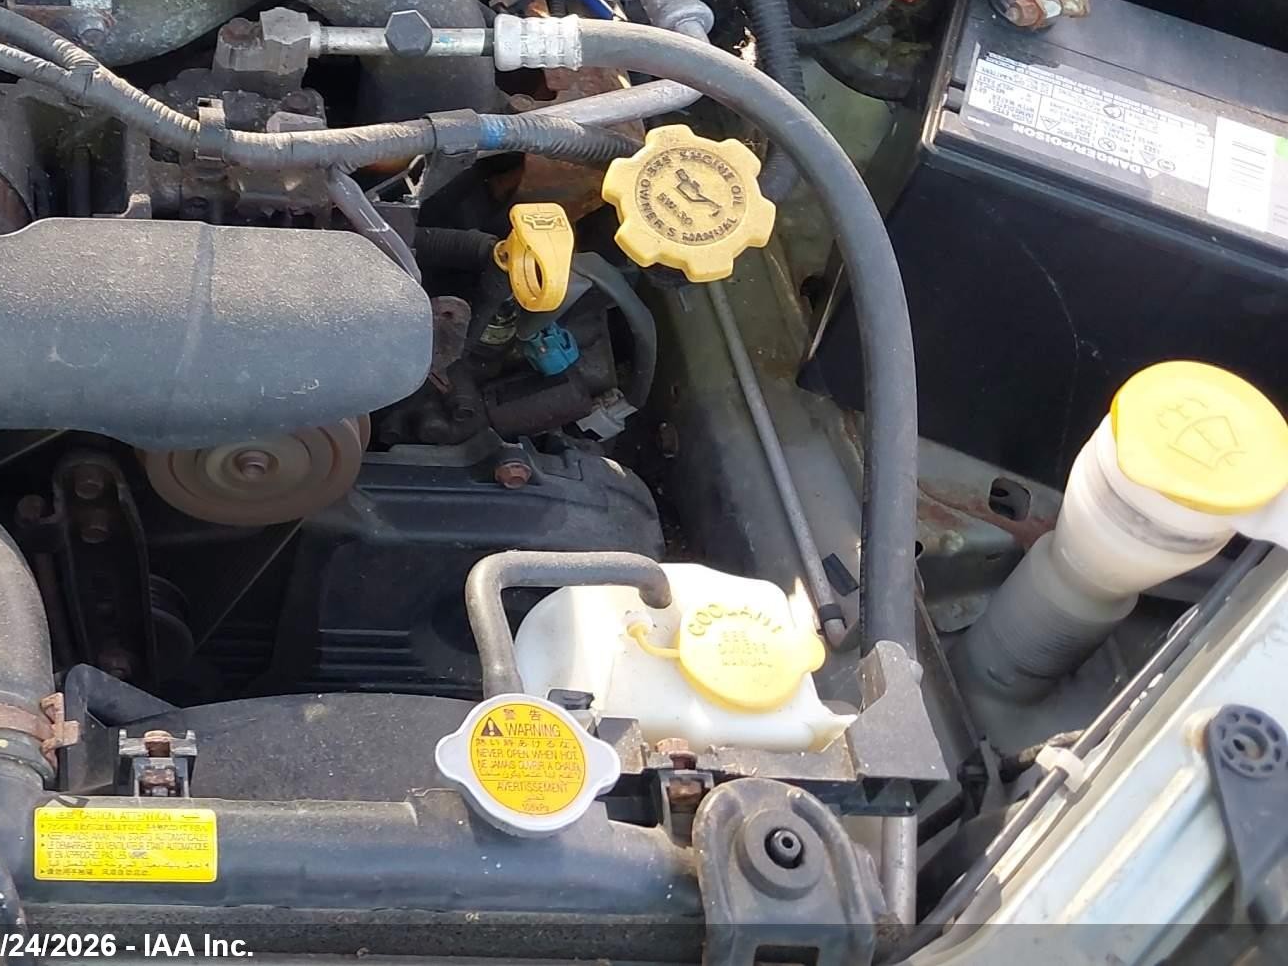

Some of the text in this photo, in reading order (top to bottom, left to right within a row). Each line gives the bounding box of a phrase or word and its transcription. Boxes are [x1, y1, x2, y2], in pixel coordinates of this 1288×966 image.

[679, 151, 744, 207] ENGINE OIL
[657, 192, 693, 226] 5W-30
[682, 217, 738, 243] MANUAL
[505, 723, 561, 737] WARNING
[476, 748, 503, 758] NEVER
[506, 749, 529, 759] OPEN
[531, 750, 558, 760] WHEN
[497, 781, 569, 794] AVERTISSEMENT
[78, 811, 116, 821] CAUTION
[119, 811, 173, 822] ATTENTION
